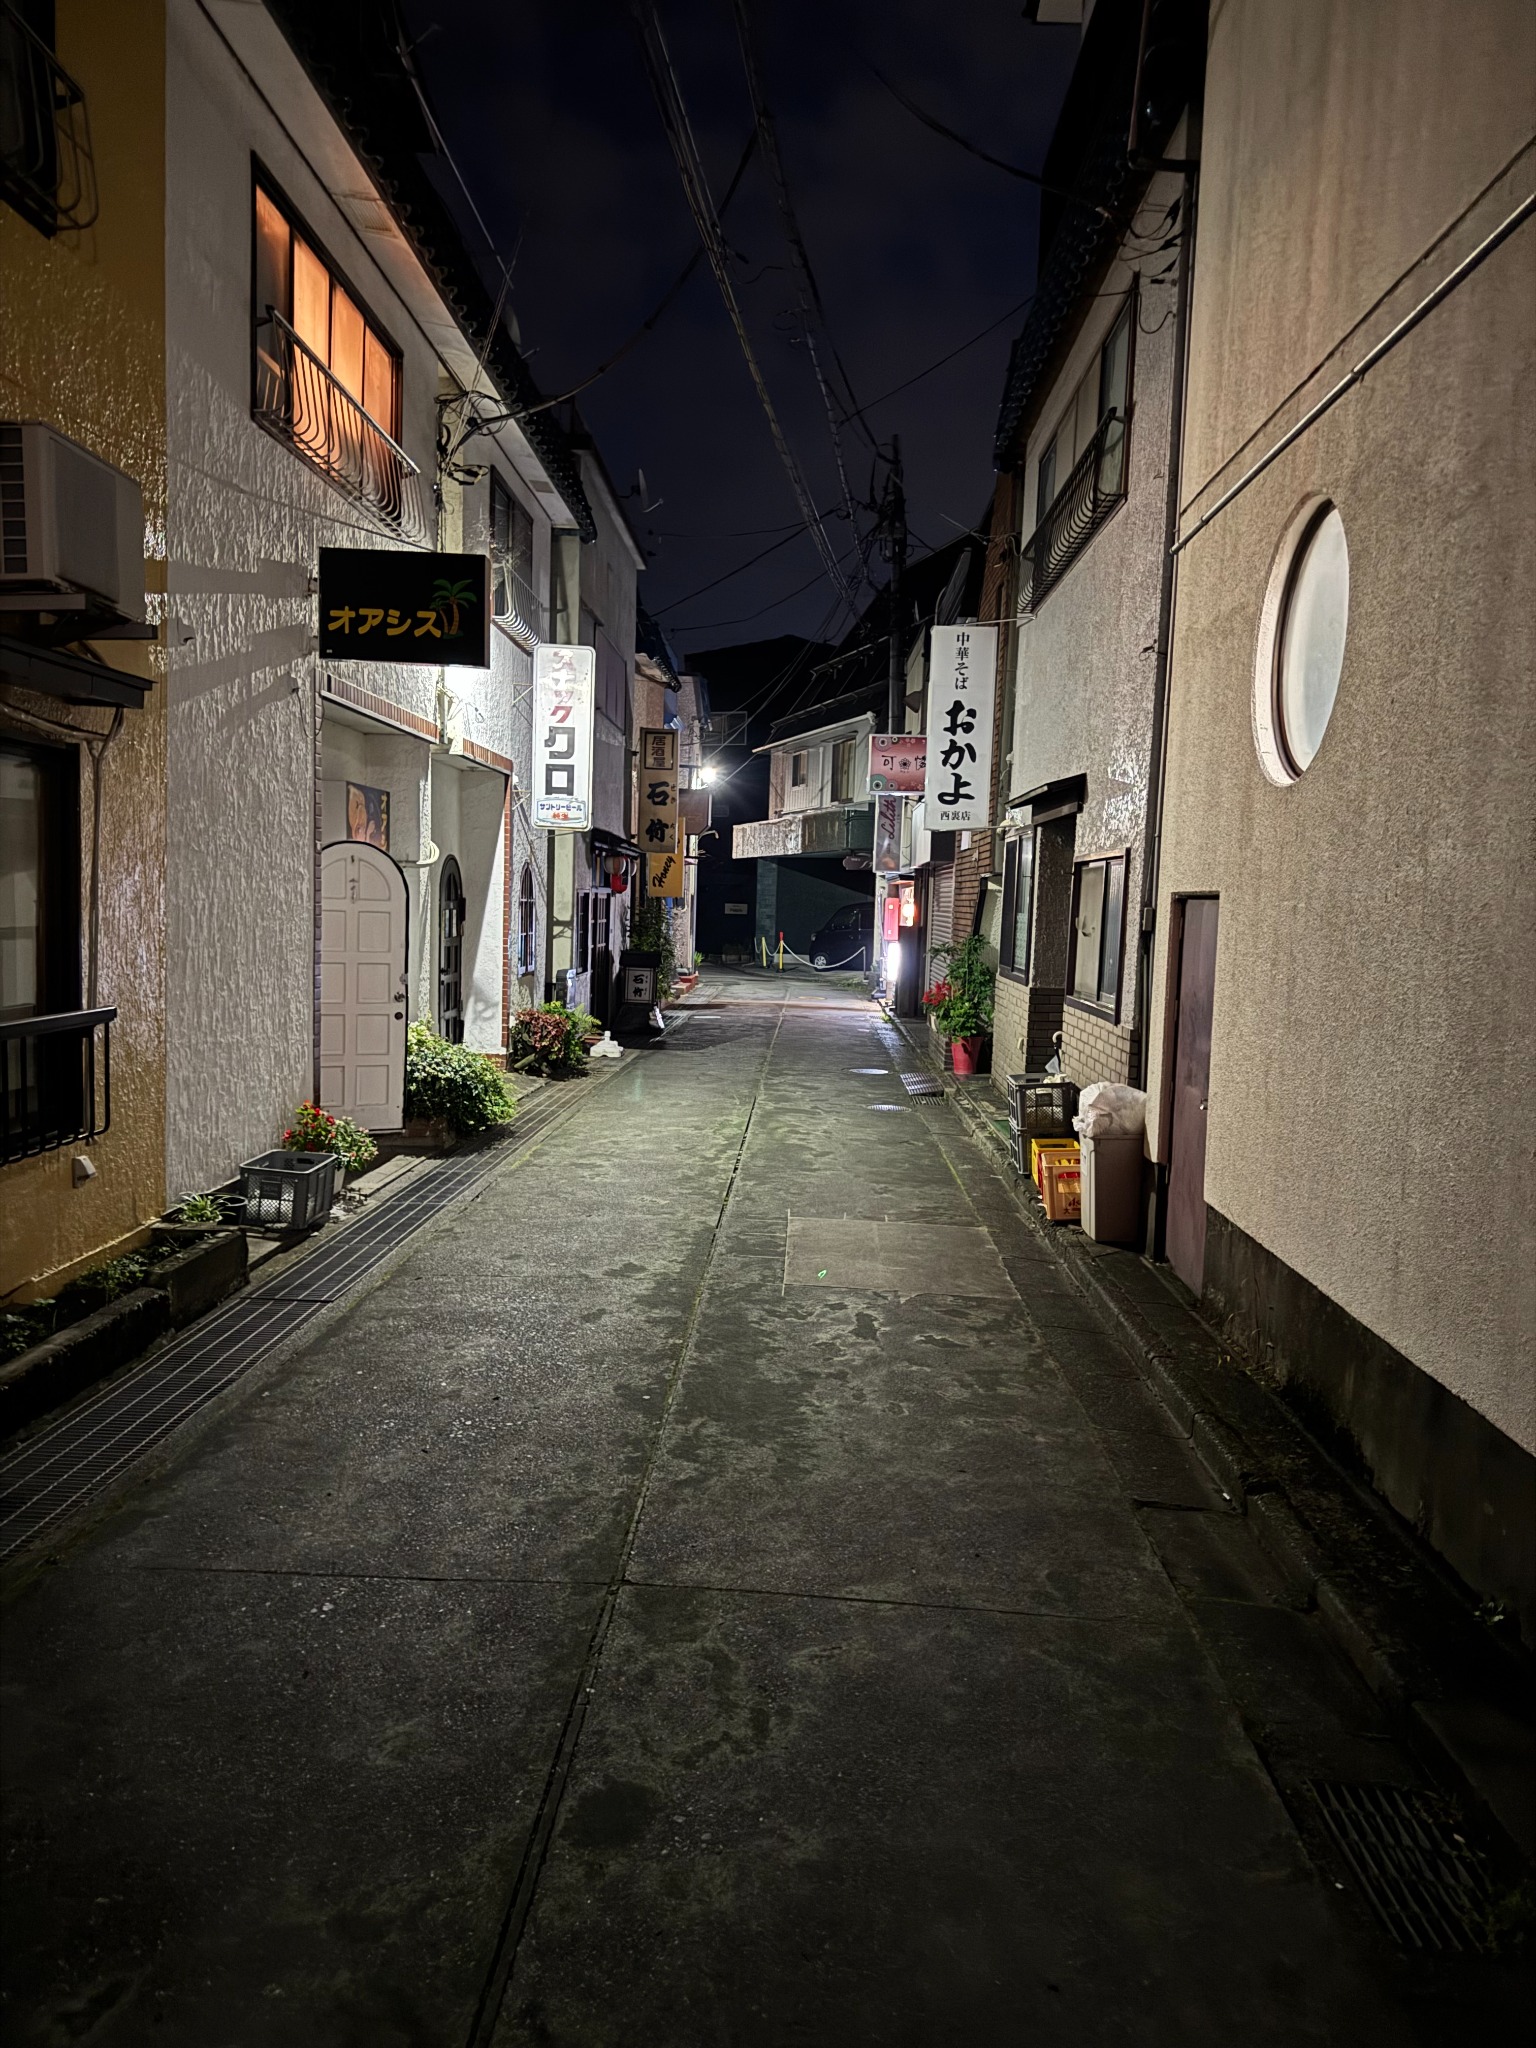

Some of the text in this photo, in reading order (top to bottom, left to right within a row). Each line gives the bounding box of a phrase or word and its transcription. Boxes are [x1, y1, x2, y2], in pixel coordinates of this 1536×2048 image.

[328, 606, 442, 638] オアシス
[954, 631, 970, 690] 中華そば
[551, 650, 576, 723] スナック
[544, 726, 576, 796] クロ
[651, 735, 667, 768] 居酒屋
[937, 699, 977, 806] おかよ
[539, 803, 583, 811] サントリービール
[940, 810, 971, 821] 西裏店
[652, 855, 676, 889] Honey
